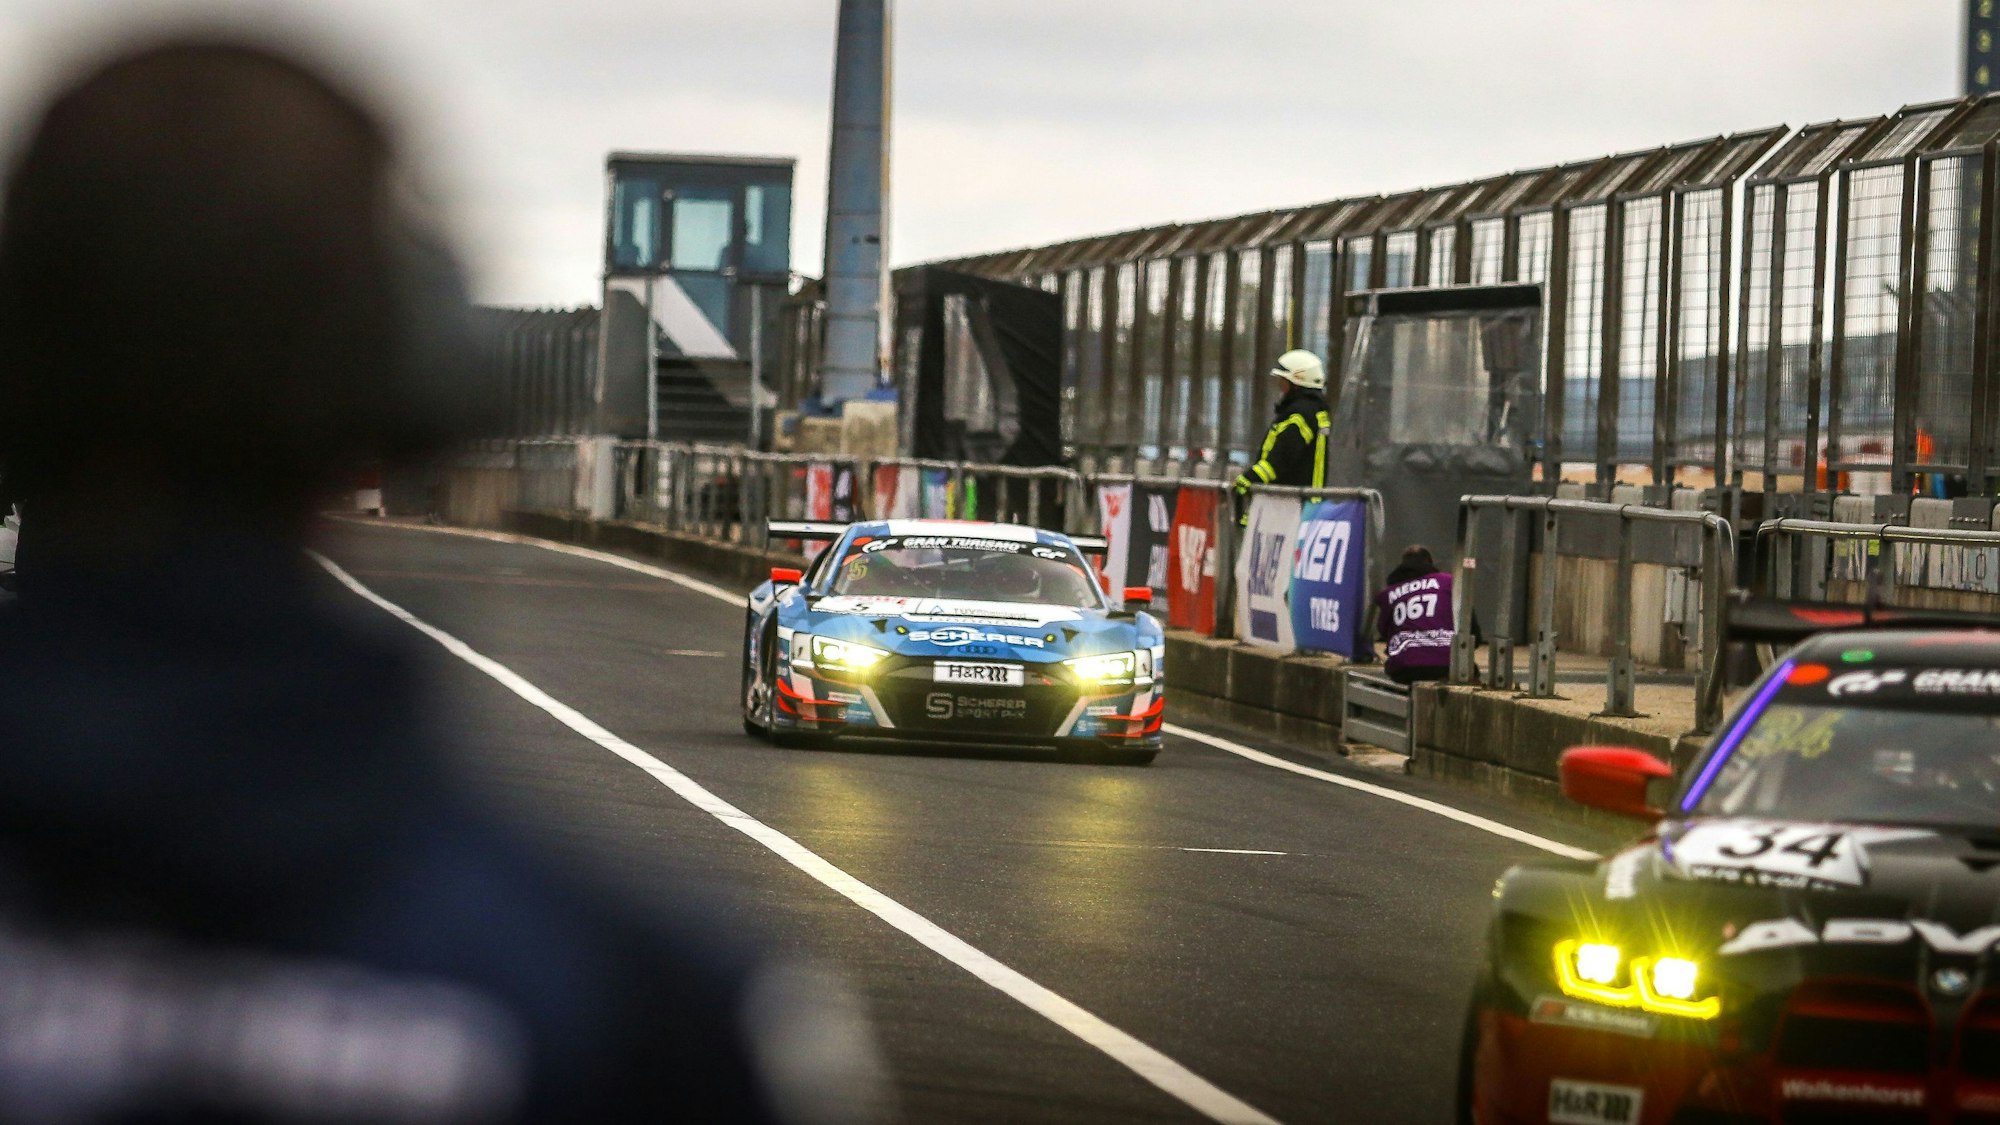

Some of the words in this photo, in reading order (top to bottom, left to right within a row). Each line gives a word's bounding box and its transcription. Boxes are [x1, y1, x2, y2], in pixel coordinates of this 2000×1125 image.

[902, 536, 949, 547] GRAN
[950, 538, 1021, 551] TURISMO
[1388, 578, 1440, 604] MEDIA
[1393, 593, 1438, 626] 067
[909, 629, 1045, 648] SCHERER
[949, 664, 985, 680] H&R
[957, 696, 1026, 710] SCHERER
[1717, 827, 1843, 867] 34
[1551, 1086, 1600, 1117] H&R
[1782, 1079, 1924, 1107] Walkenhorst
